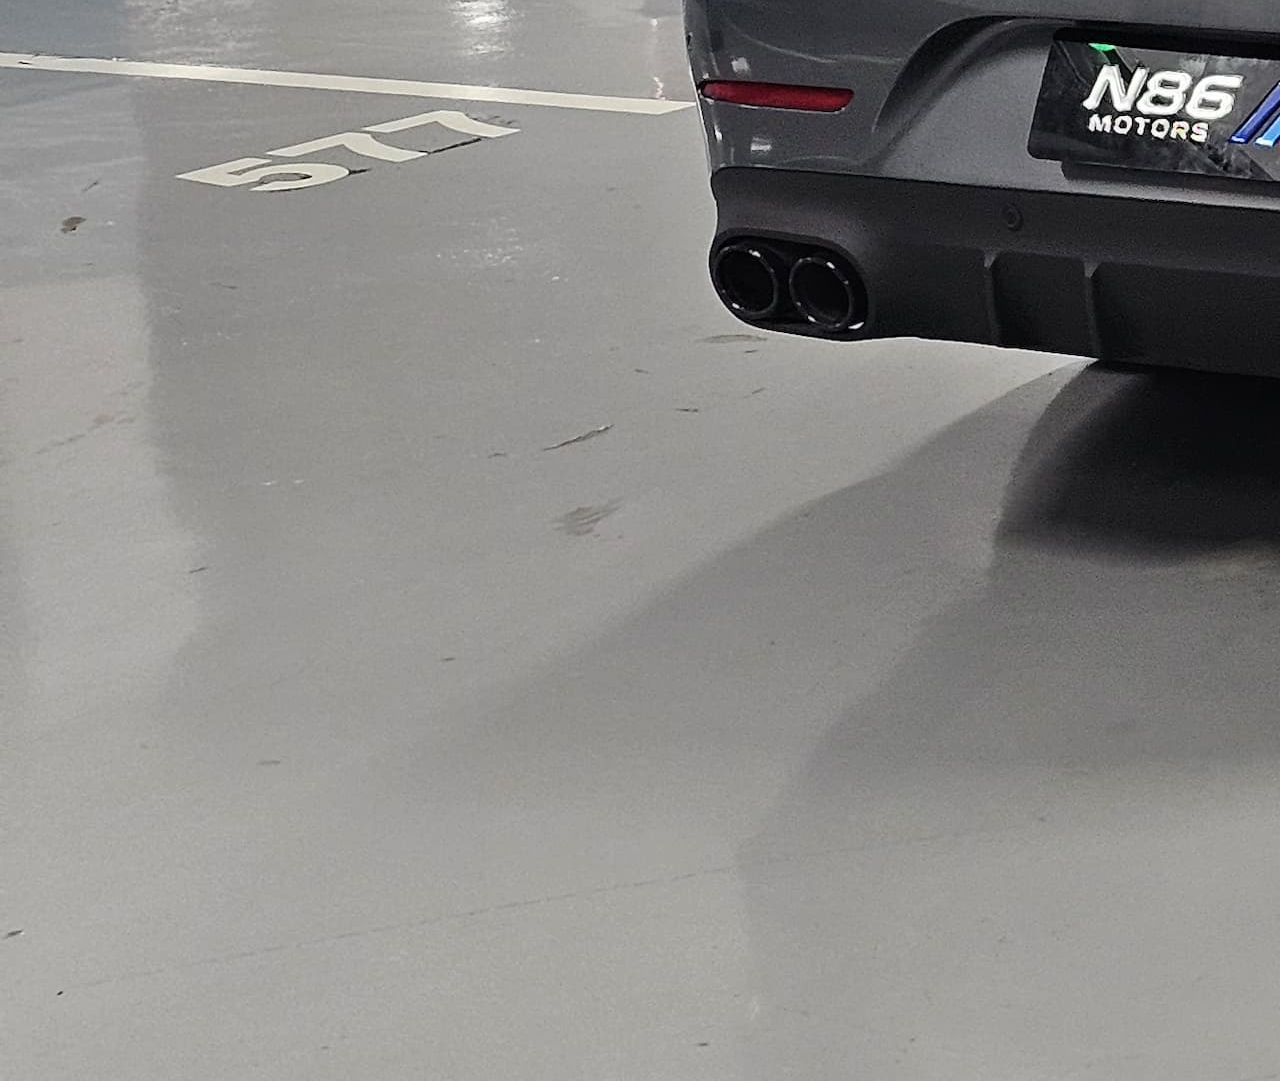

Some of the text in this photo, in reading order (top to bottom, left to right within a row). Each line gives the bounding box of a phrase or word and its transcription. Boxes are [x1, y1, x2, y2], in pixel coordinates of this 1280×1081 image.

[1082, 63, 1245, 120] N86
[175, 109, 521, 192] 577
[1087, 113, 1210, 143] MOTORS
